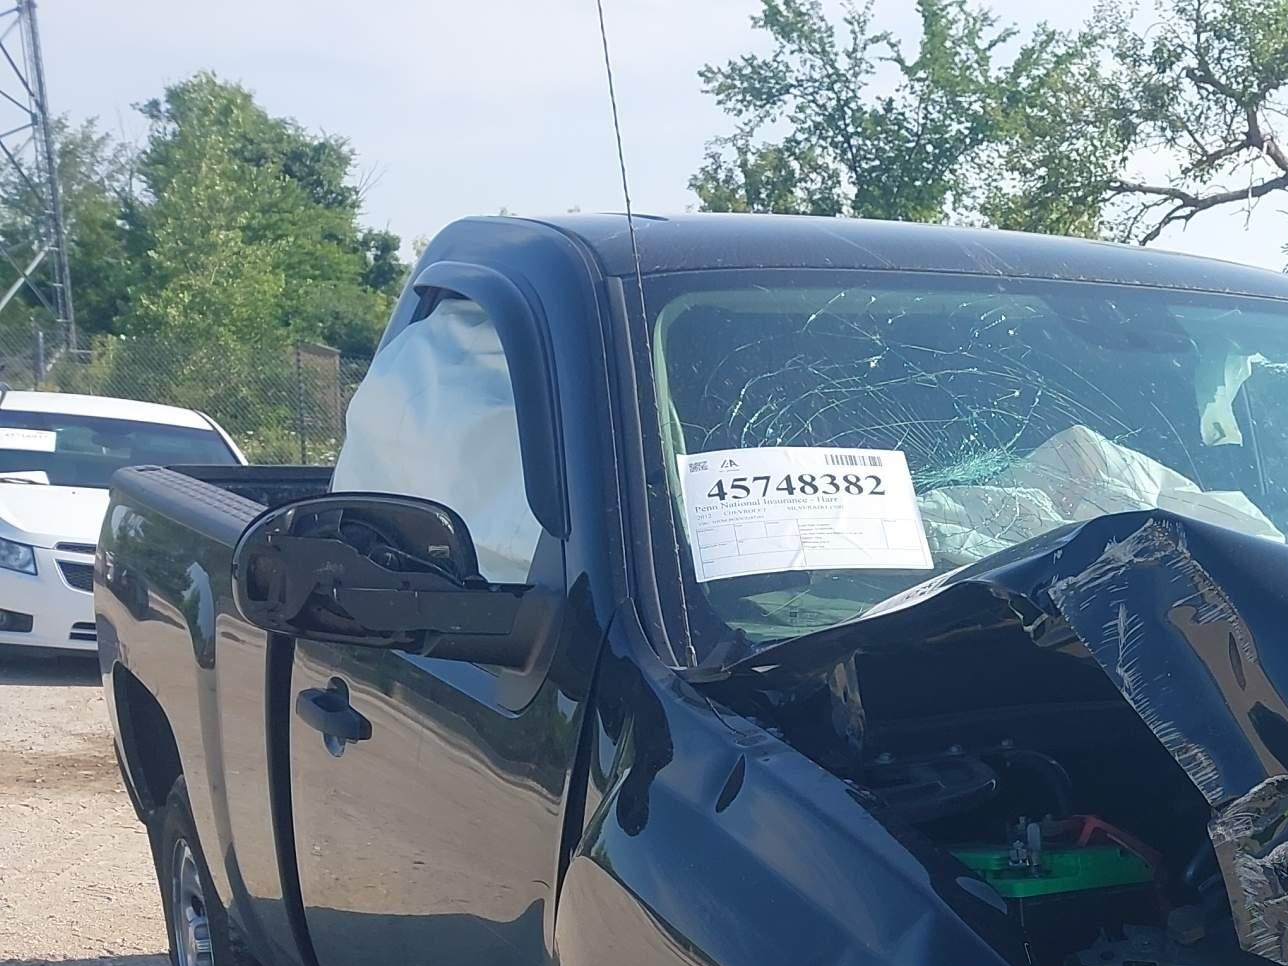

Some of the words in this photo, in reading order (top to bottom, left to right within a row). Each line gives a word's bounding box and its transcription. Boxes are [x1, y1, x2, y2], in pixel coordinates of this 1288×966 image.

[707, 473, 886, 500] 45748382
[695, 504, 718, 513] Penn
[720, 499, 761, 509] National
